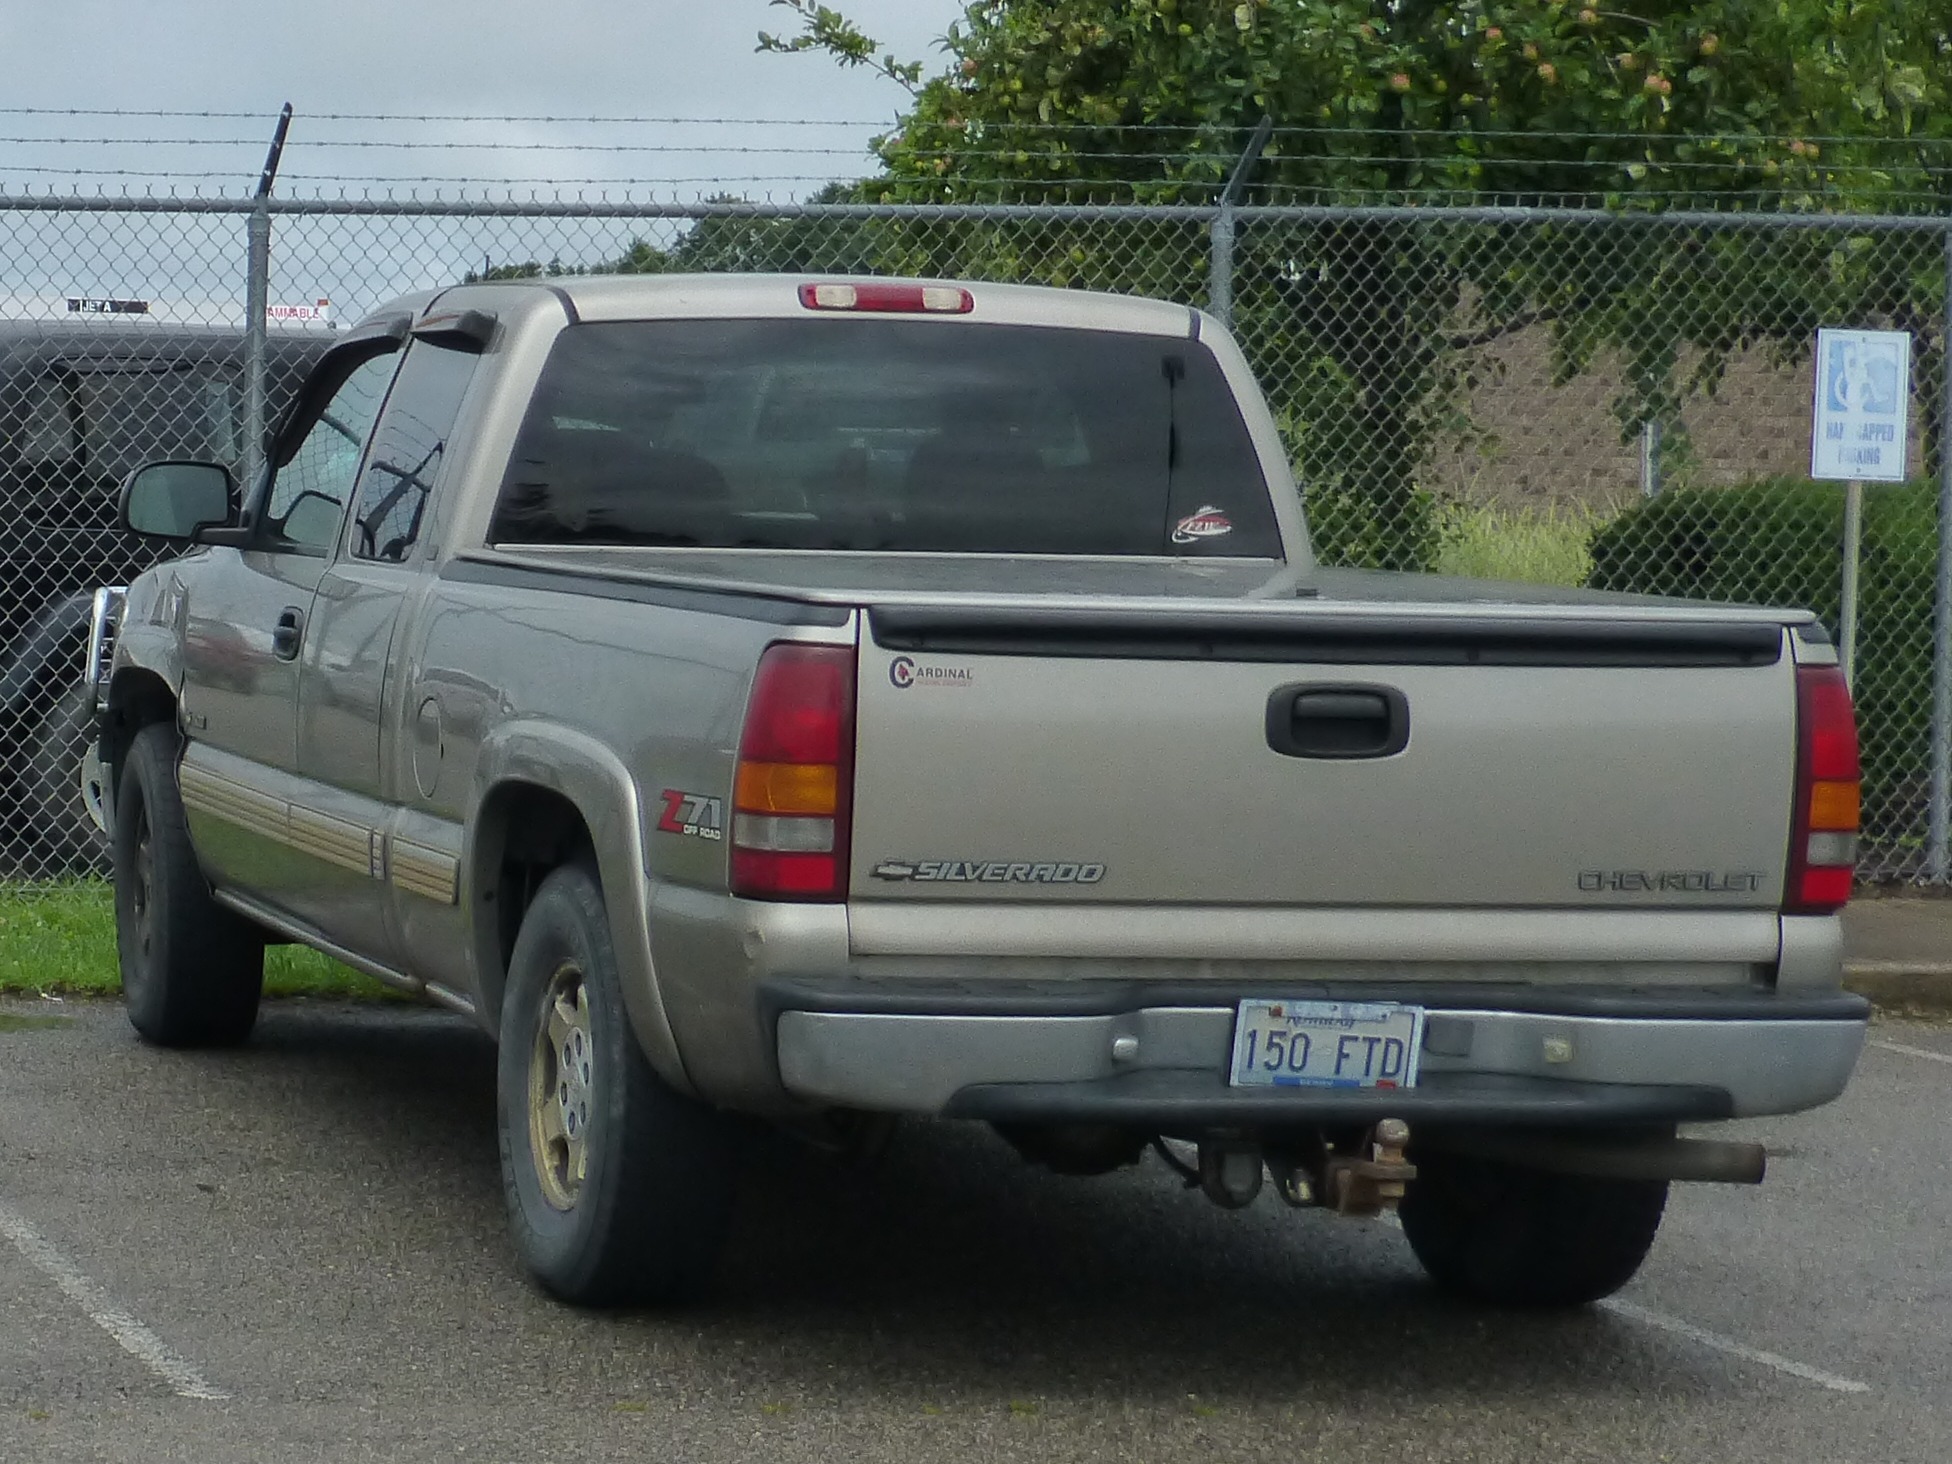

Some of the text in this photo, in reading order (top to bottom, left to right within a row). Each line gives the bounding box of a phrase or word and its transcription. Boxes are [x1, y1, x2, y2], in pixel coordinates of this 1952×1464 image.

[103, 301, 112, 312] A
[267, 306, 319, 319] AMMABLE
[889, 656, 973, 689] CARDINAL
[657, 788, 721, 833] Z71
[683, 824, 721, 841] OFF ROAD
[913, 861, 1105, 883] SILVERADO
[1577, 871, 1768, 892] CHEVROLET
[1247, 1029, 1405, 1078] 150 FTD
